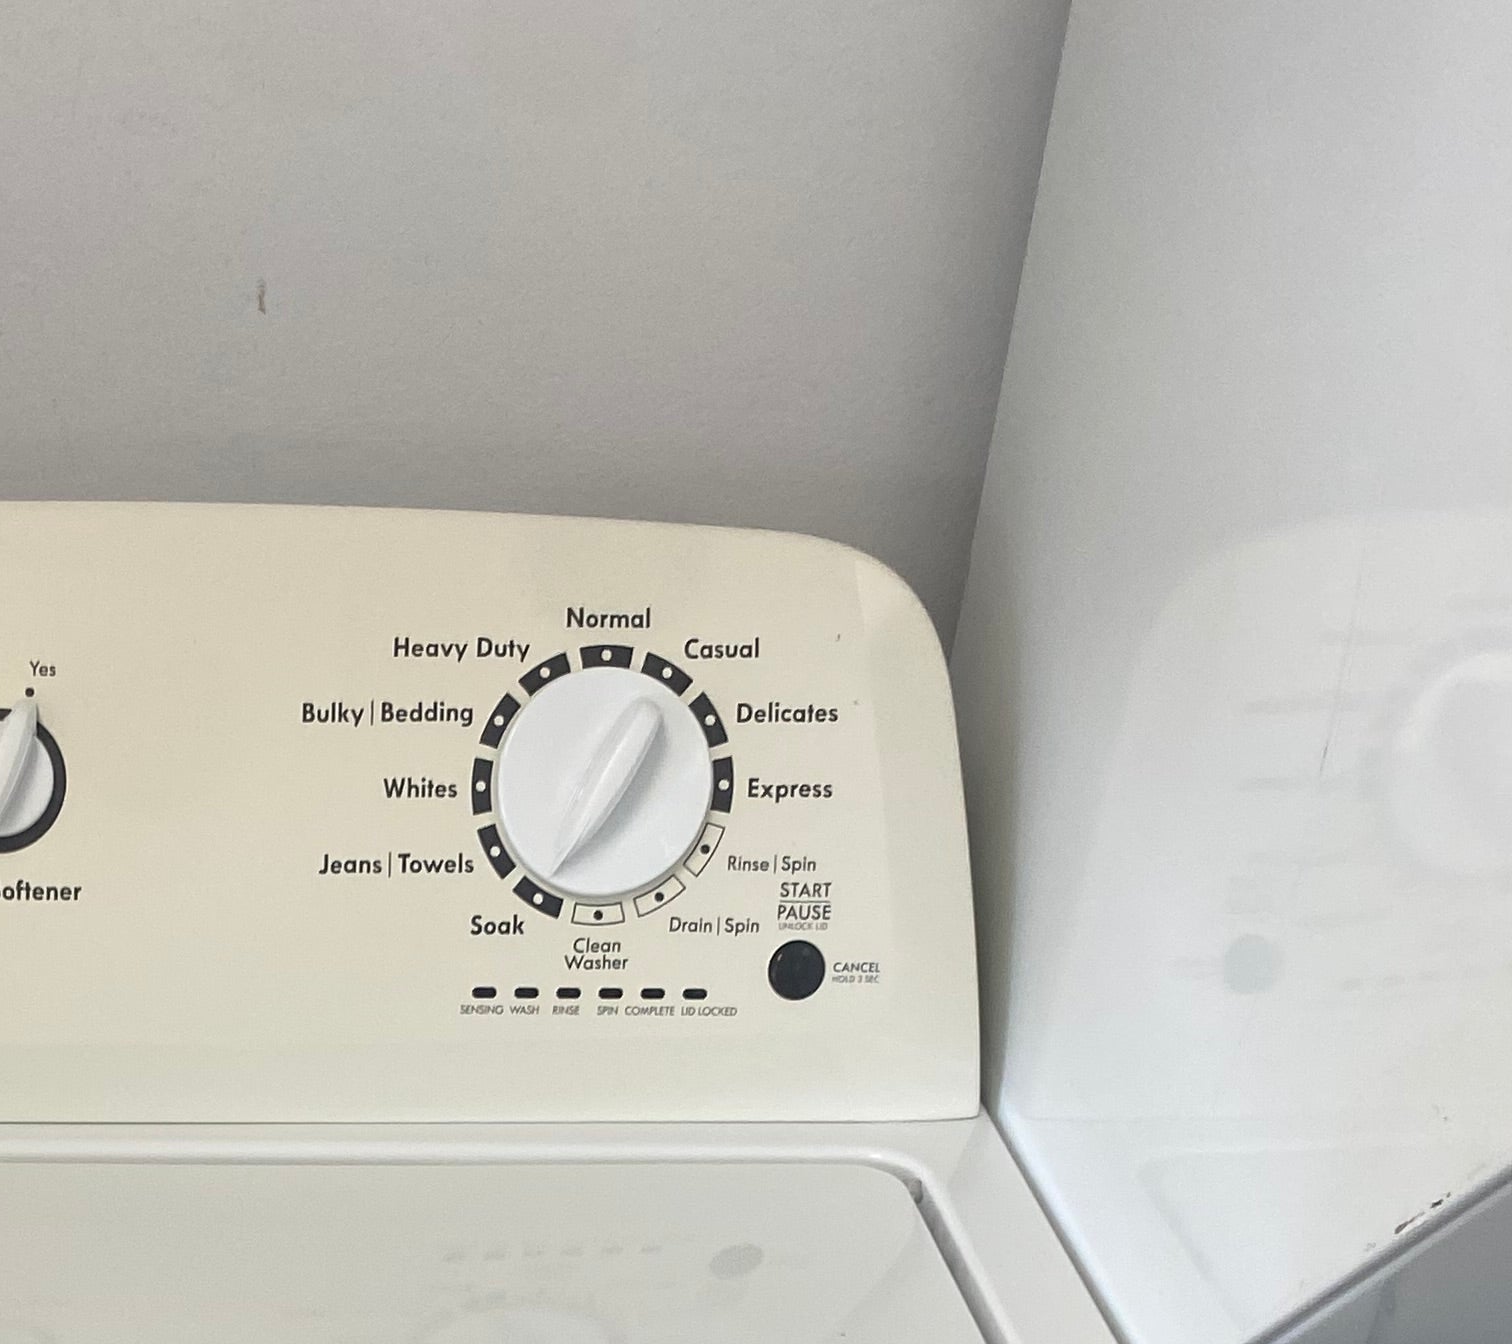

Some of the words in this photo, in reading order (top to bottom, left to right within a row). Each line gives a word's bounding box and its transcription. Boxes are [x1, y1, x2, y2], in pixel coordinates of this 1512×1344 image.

[566, 606, 651, 629] Normal
[393, 636, 469, 663] Heavy
[476, 636, 531, 663] Duty
[684, 637, 760, 660] Casual
[29, 660, 57, 677] Yes
[302, 701, 365, 728] Bulky
[380, 700, 474, 728] Bedding
[736, 701, 839, 724] Delicates
[383, 776, 458, 799] Whites
[747, 777, 833, 804] Express
[318, 853, 383, 875] Jeans
[397, 852, 475, 874] Towels
[727, 854, 770, 872] Rinse
[780, 855, 817, 876] Spin
[779, 881, 833, 899] START
[777, 903, 832, 921] PAUSE
[470, 914, 525, 936] Soak
[668, 916, 713, 934] Drain
[724, 916, 760, 937] Spin
[572, 936, 622, 954] Clean
[564, 954, 629, 971] Washer
[832, 961, 881, 974] CANCEL
[459, 1004, 504, 1016] SENSING
[509, 1004, 541, 1016] WASH
[551, 1005, 580, 1016] RINSE
[596, 1005, 619, 1016] SPIN
[624, 1005, 676, 1017] COMPLETE
[697, 1006, 738, 1017] LOCKED
